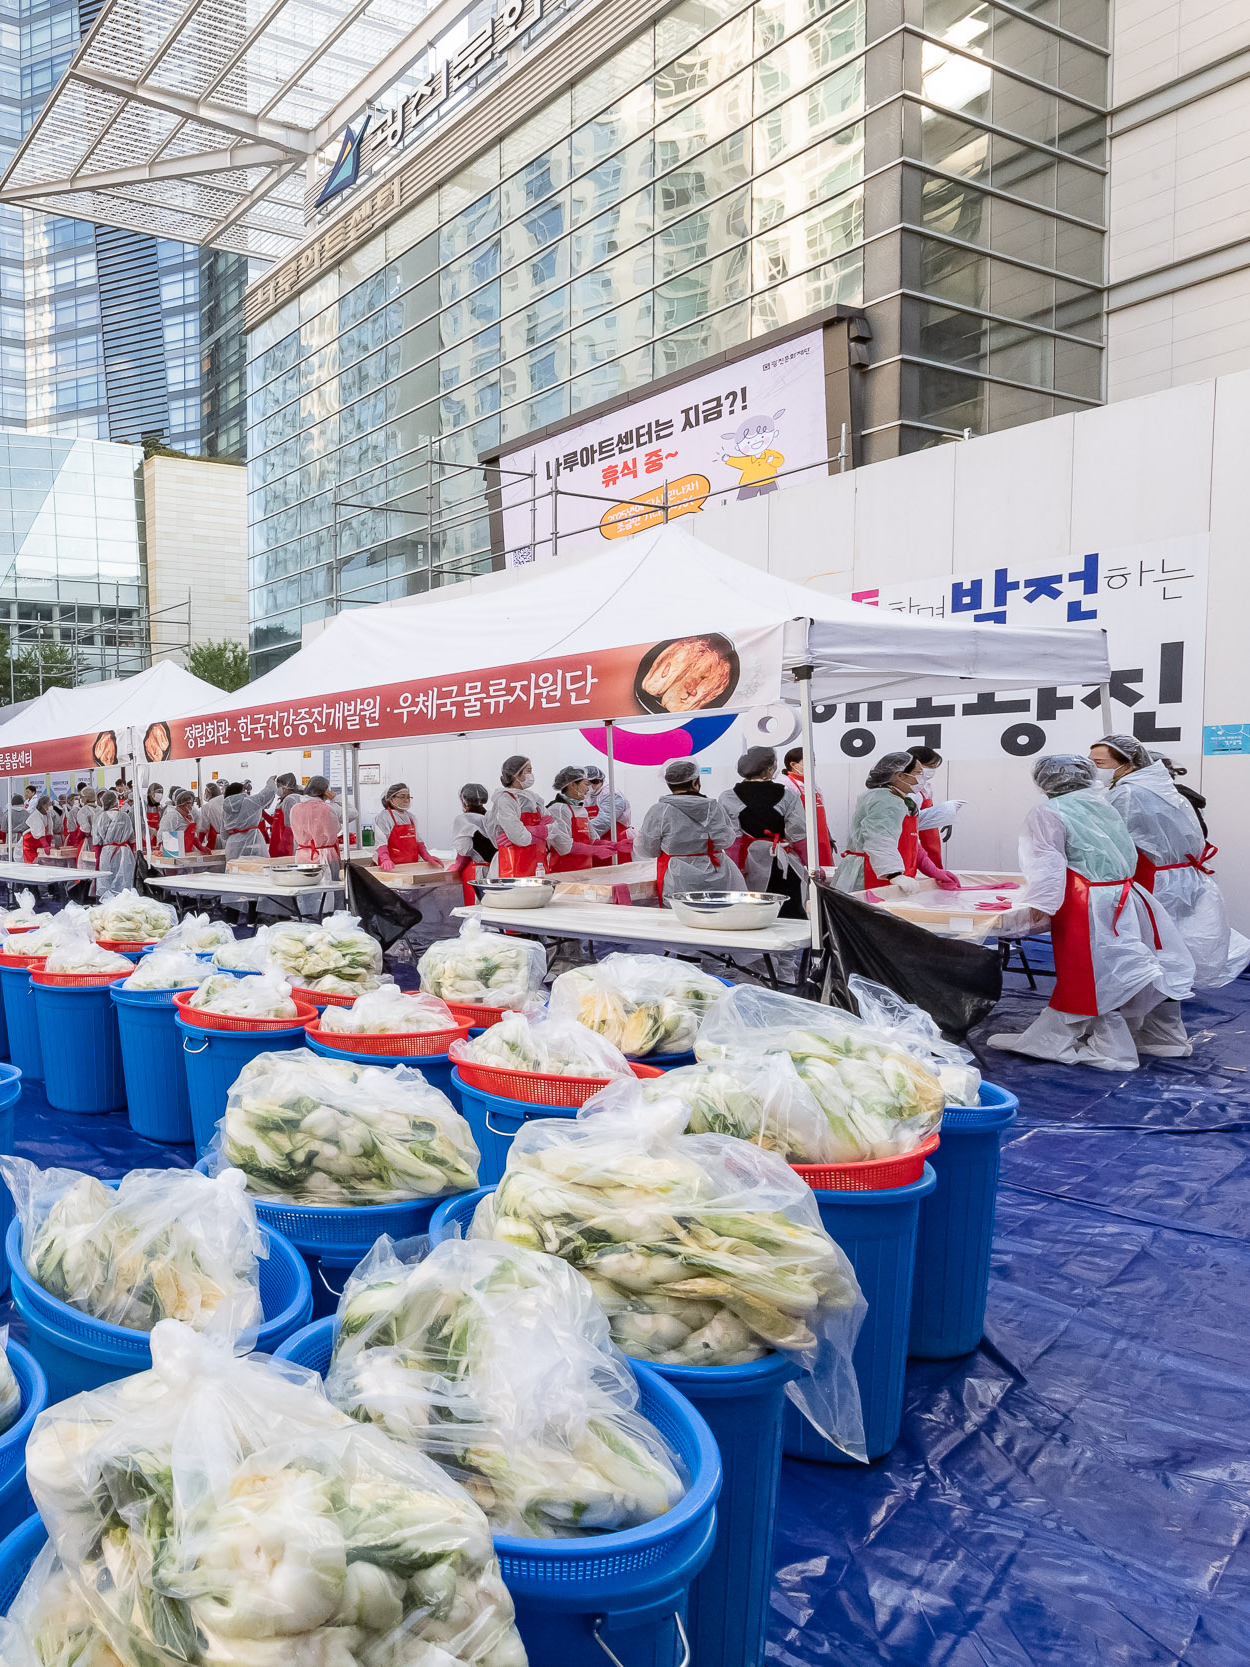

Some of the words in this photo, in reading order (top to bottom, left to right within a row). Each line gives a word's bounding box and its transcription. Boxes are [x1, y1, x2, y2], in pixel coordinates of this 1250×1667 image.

[257, 175, 402, 304] 나루아트센터
[545, 418, 674, 481] 나루아트센터는
[680, 386, 748, 432] 지금?!
[601, 457, 638, 488] 휴식
[393, 664, 599, 724] 우체국물류지원단
